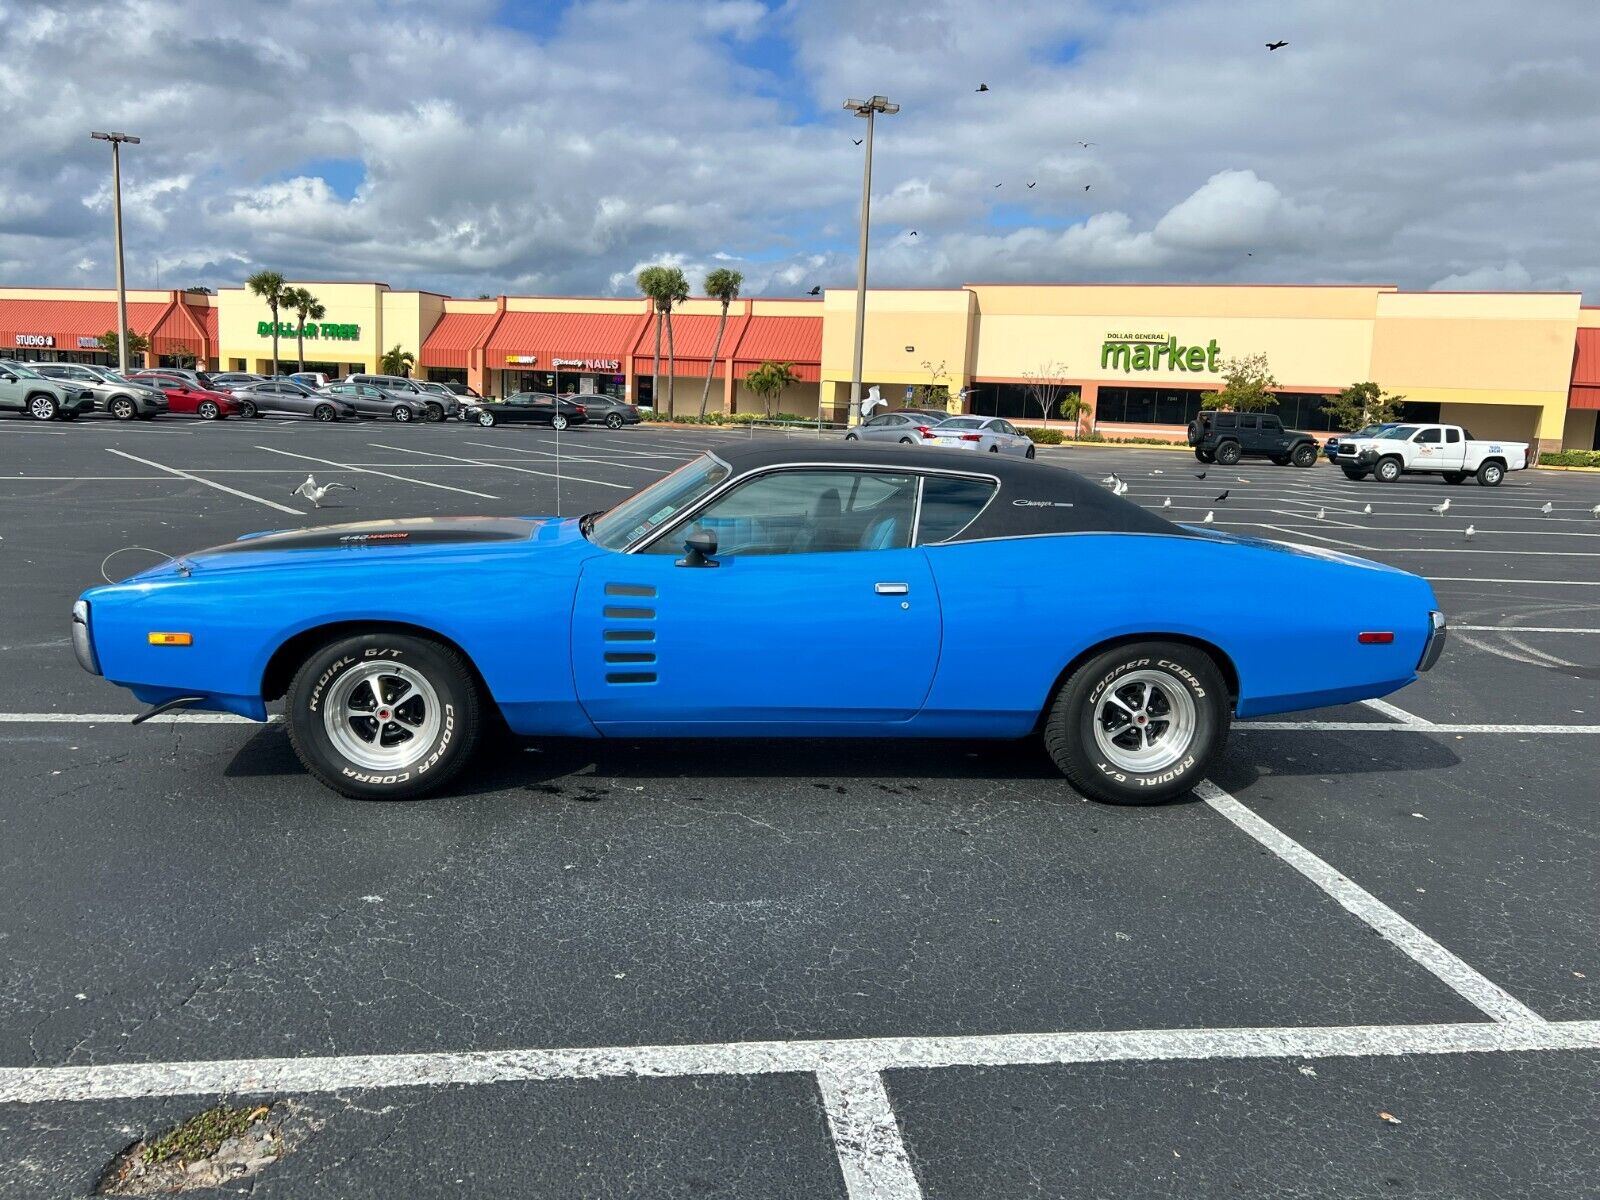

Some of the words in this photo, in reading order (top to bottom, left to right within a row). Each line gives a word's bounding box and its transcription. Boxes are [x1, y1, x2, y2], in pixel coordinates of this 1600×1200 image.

[15, 334, 45, 346] STUDIO
[320, 323, 359, 339] TREE
[505, 355, 536, 364] SUBWAY
[552, 358, 584, 367] Beauty
[586, 359, 619, 369] NAILS
[1100, 336, 1220, 373] market
[1012, 499, 1052, 508] Charger
[309, 655, 356, 712] RADIAL
[364, 648, 404, 658] G/T
[1089, 658, 1150, 705] COOPER
[1157, 659, 1206, 698] COBRA
[417, 703, 455, 775] COOPER
[342, 766, 410, 784] COBRA
[1097, 762, 1127, 783] G/T
[1135, 755, 1196, 787] RADIAL
